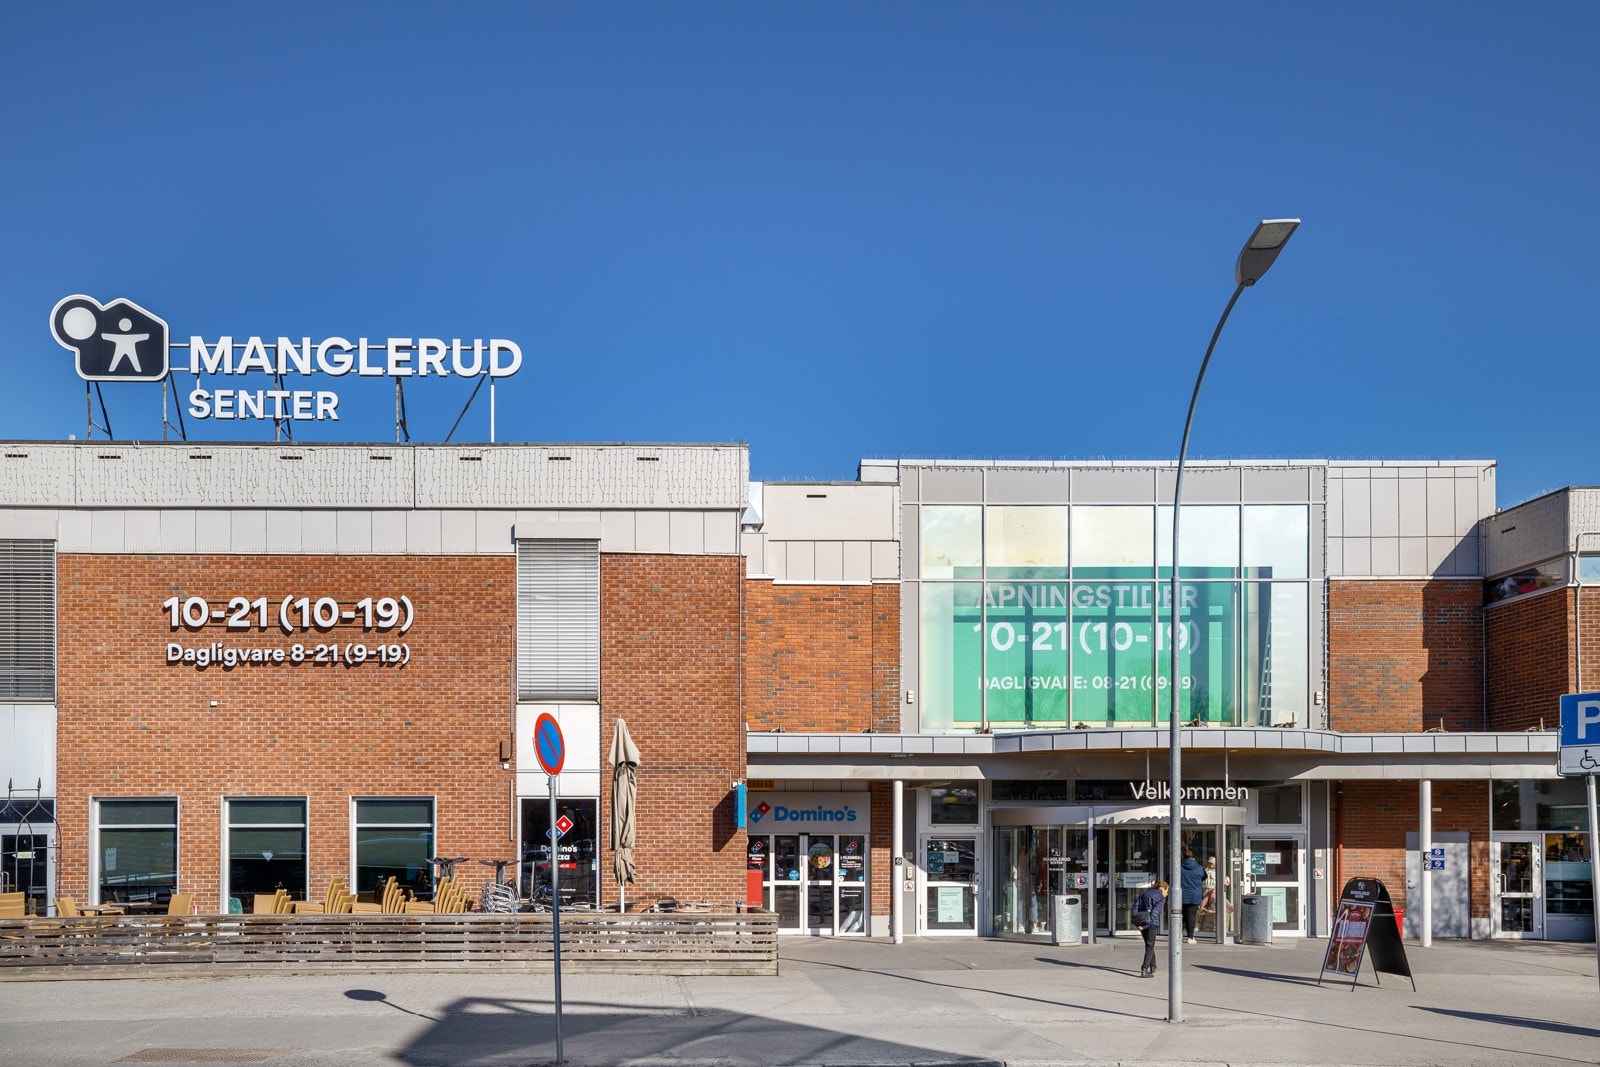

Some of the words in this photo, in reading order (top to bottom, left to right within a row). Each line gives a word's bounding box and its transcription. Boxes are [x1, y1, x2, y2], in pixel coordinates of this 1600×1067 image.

[190, 335, 523, 377] MANGLERUD
[188, 389, 339, 420] SENTER
[163, 596, 268, 628] 10-21
[280, 594, 414, 632] (10-19)
[1080, 619, 1200, 655] (10-19)
[167, 643, 285, 666] Dagligvare
[291, 643, 338, 662] 8-21
[344, 643, 410, 664] (9-19)
[1092, 676, 1136, 689] 08-21
[1141, 675, 1197, 691] (9-9)
[1578, 700, 1600, 739] P
[774, 805, 857, 822] Domino's
[540, 844, 578, 852] Doino's
